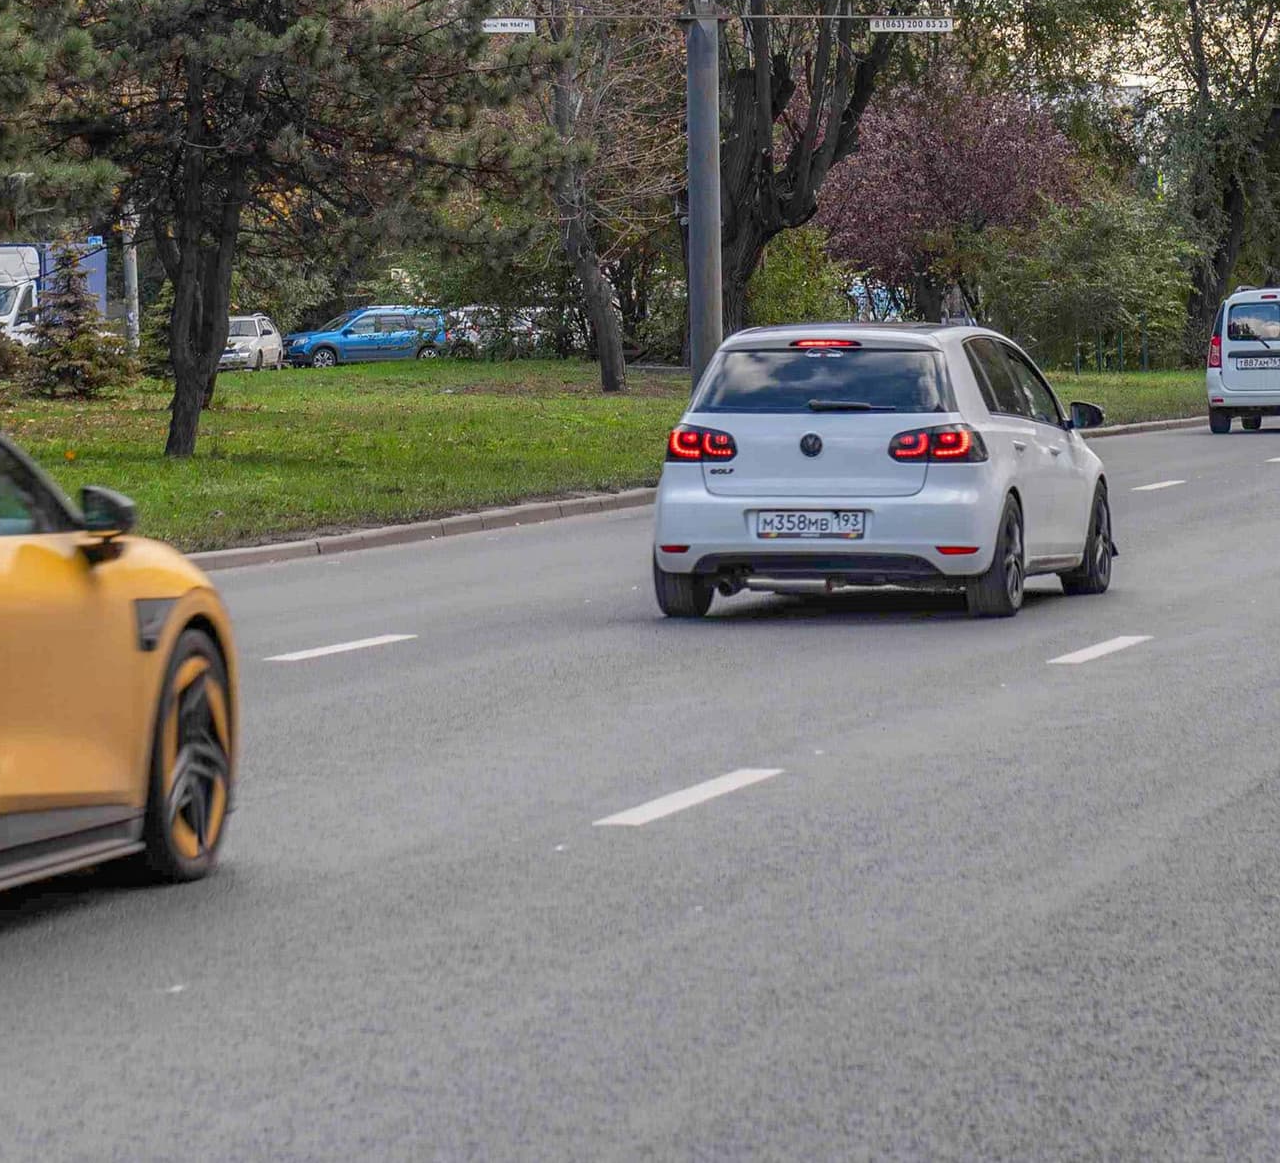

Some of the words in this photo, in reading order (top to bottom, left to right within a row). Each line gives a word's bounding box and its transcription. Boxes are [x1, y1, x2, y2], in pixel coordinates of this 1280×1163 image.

[882, 20, 905, 30] (863)
[907, 20, 923, 28] 200
[762, 514, 829, 531] М358МВ
